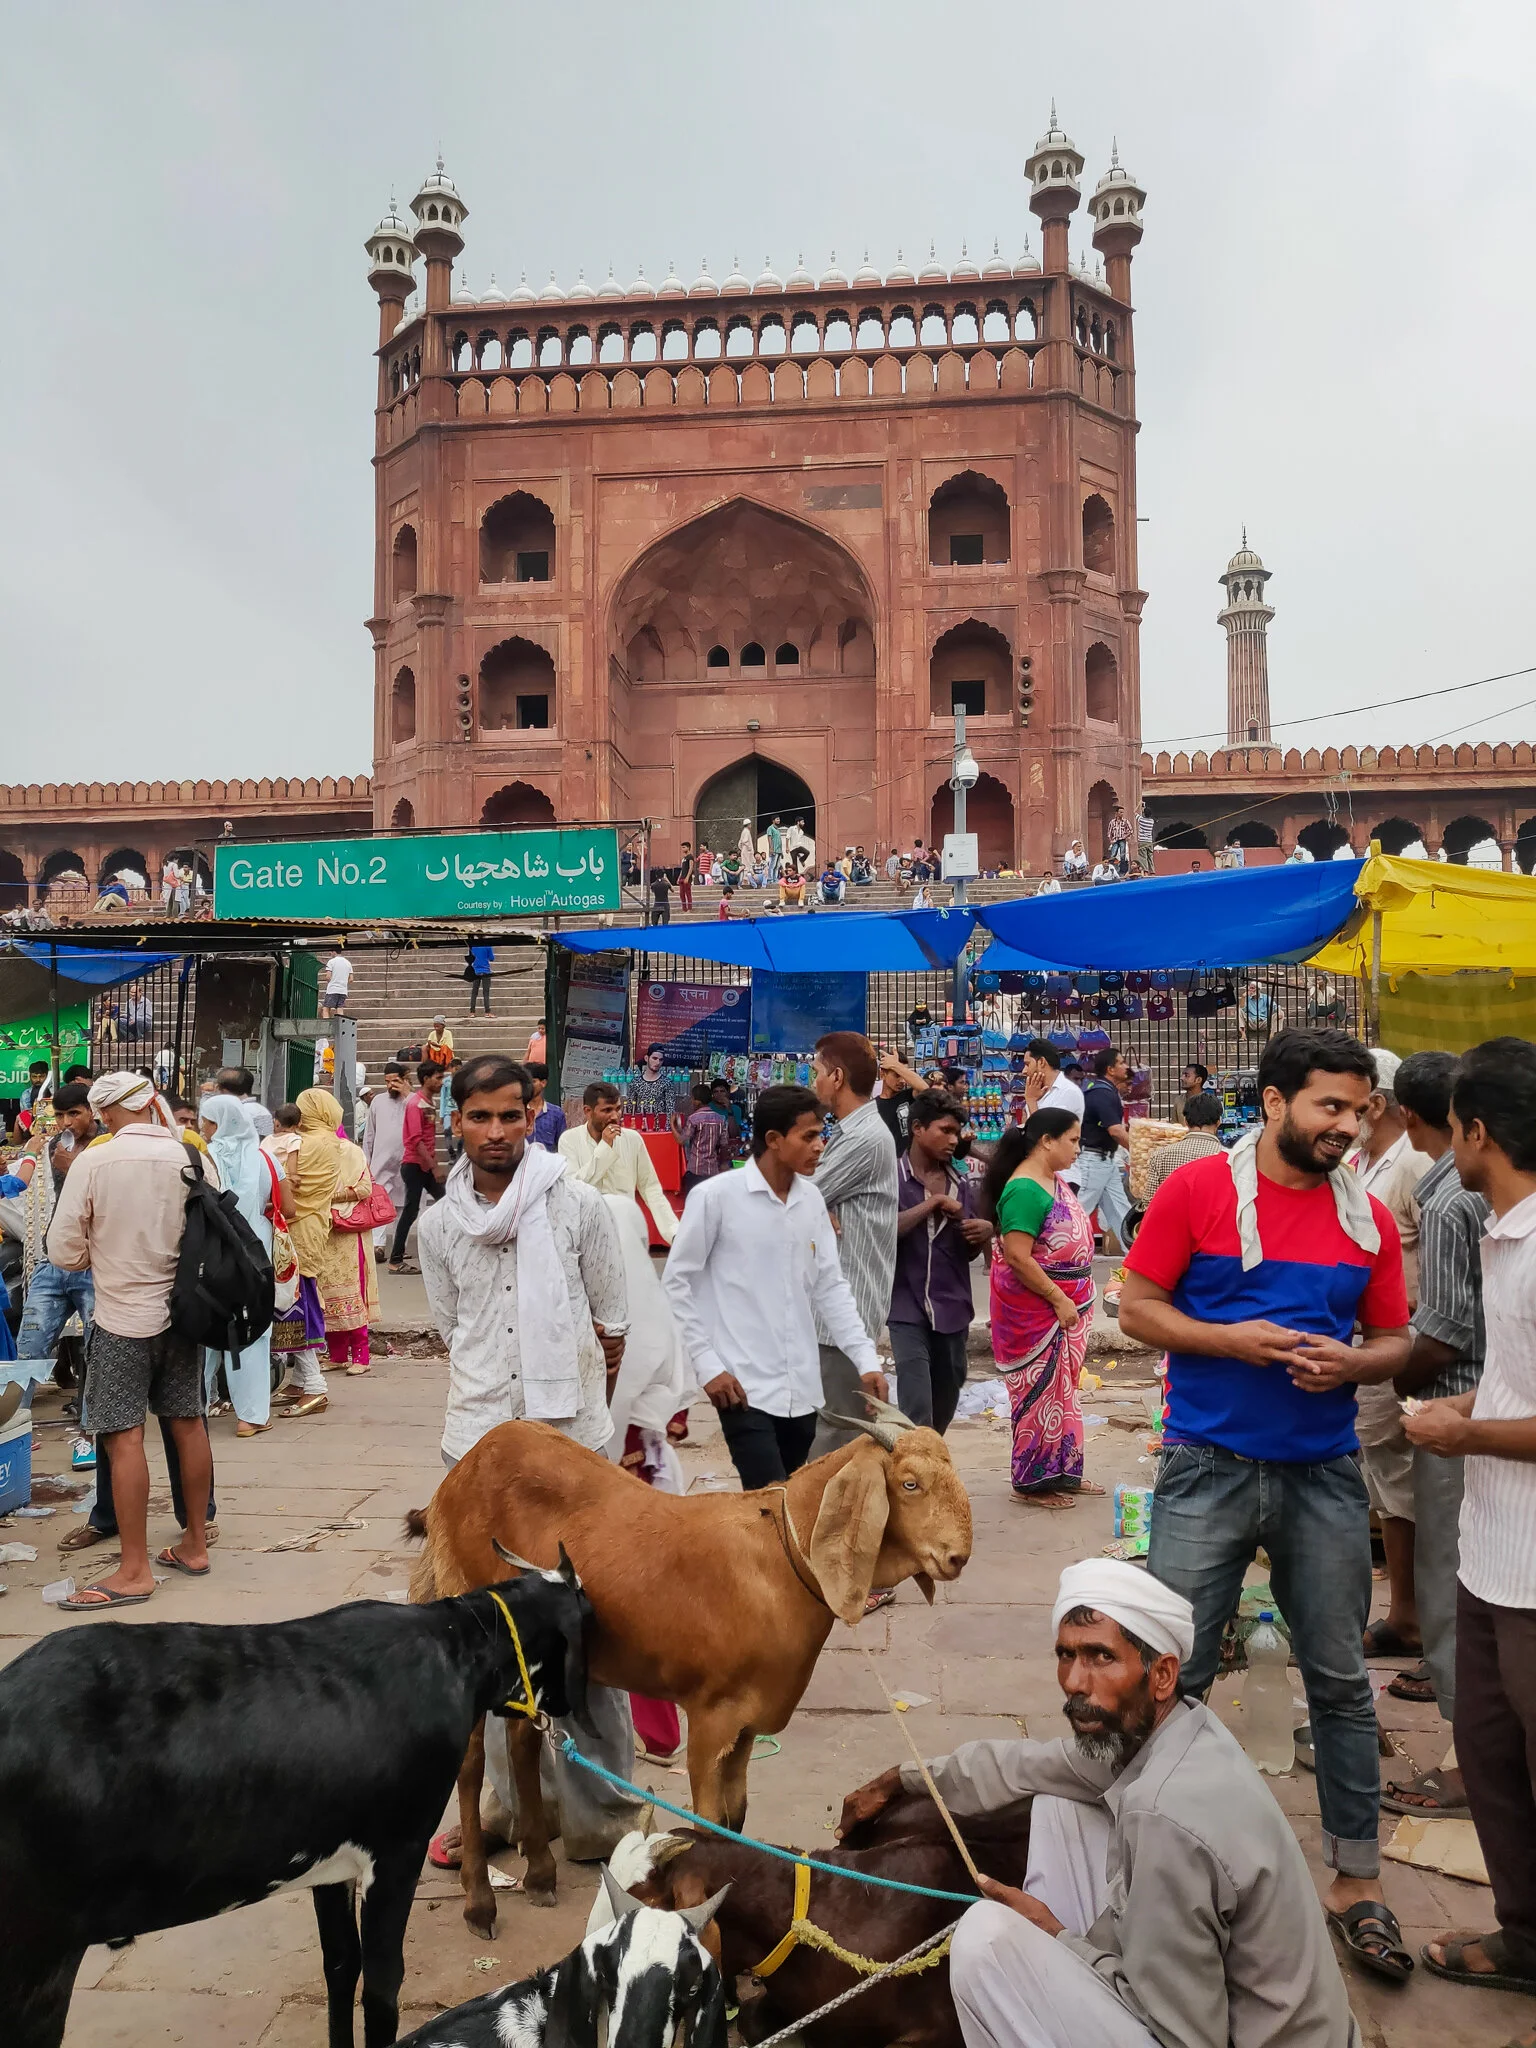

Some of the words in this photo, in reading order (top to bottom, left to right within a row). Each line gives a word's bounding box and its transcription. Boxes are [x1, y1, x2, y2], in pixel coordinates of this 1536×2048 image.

[229, 859, 303, 890] Gate
[317, 856, 388, 886] No.2
[555, 847, 605, 884] باب
[457, 901, 491, 910] Courtesy
[510, 895, 546, 908] Hovel
[551, 894, 605, 909] Autogas
[679, 988, 709, 1002] सूचना
